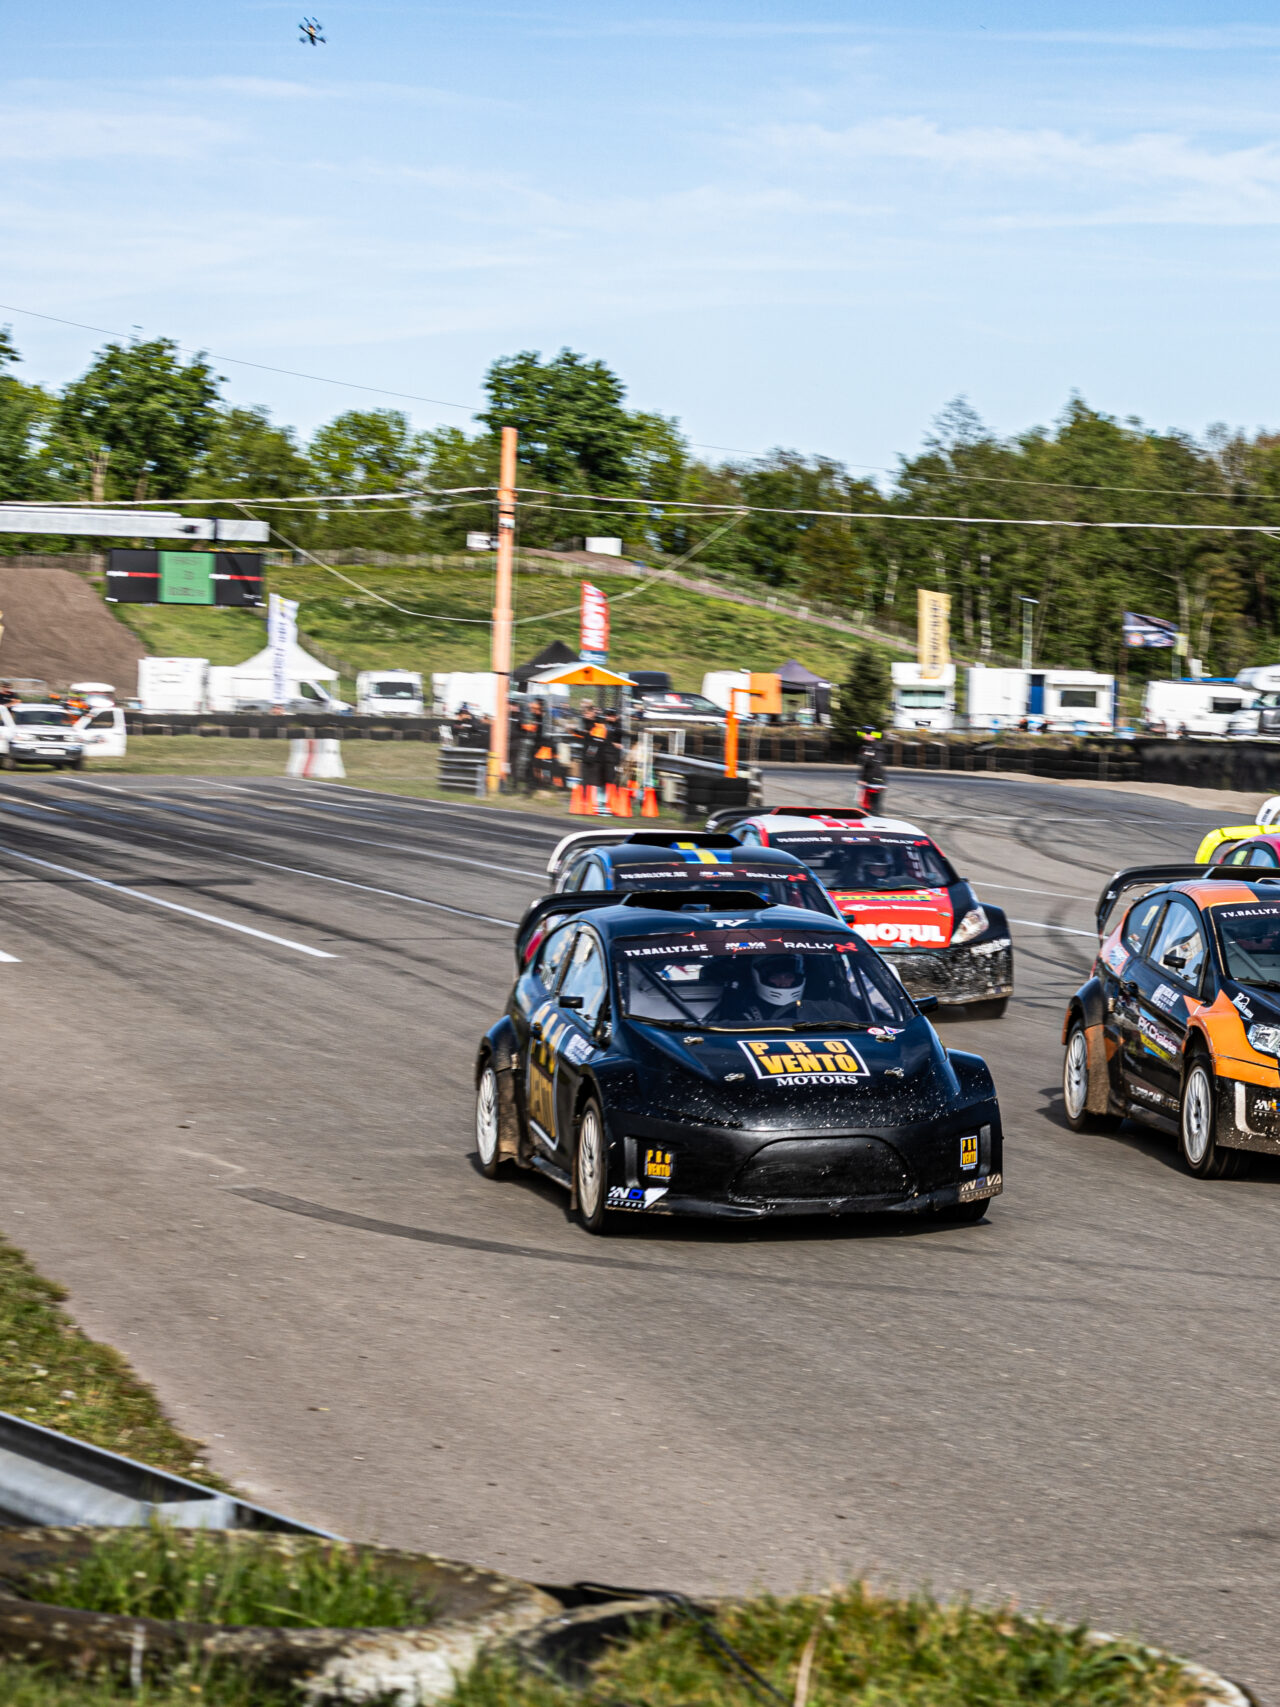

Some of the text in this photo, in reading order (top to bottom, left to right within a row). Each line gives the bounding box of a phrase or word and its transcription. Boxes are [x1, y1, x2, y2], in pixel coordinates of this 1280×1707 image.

[852, 923, 946, 943] MOTUL
[758, 1053, 859, 1075] VENTO
[776, 1075, 859, 1087] MOTORS
